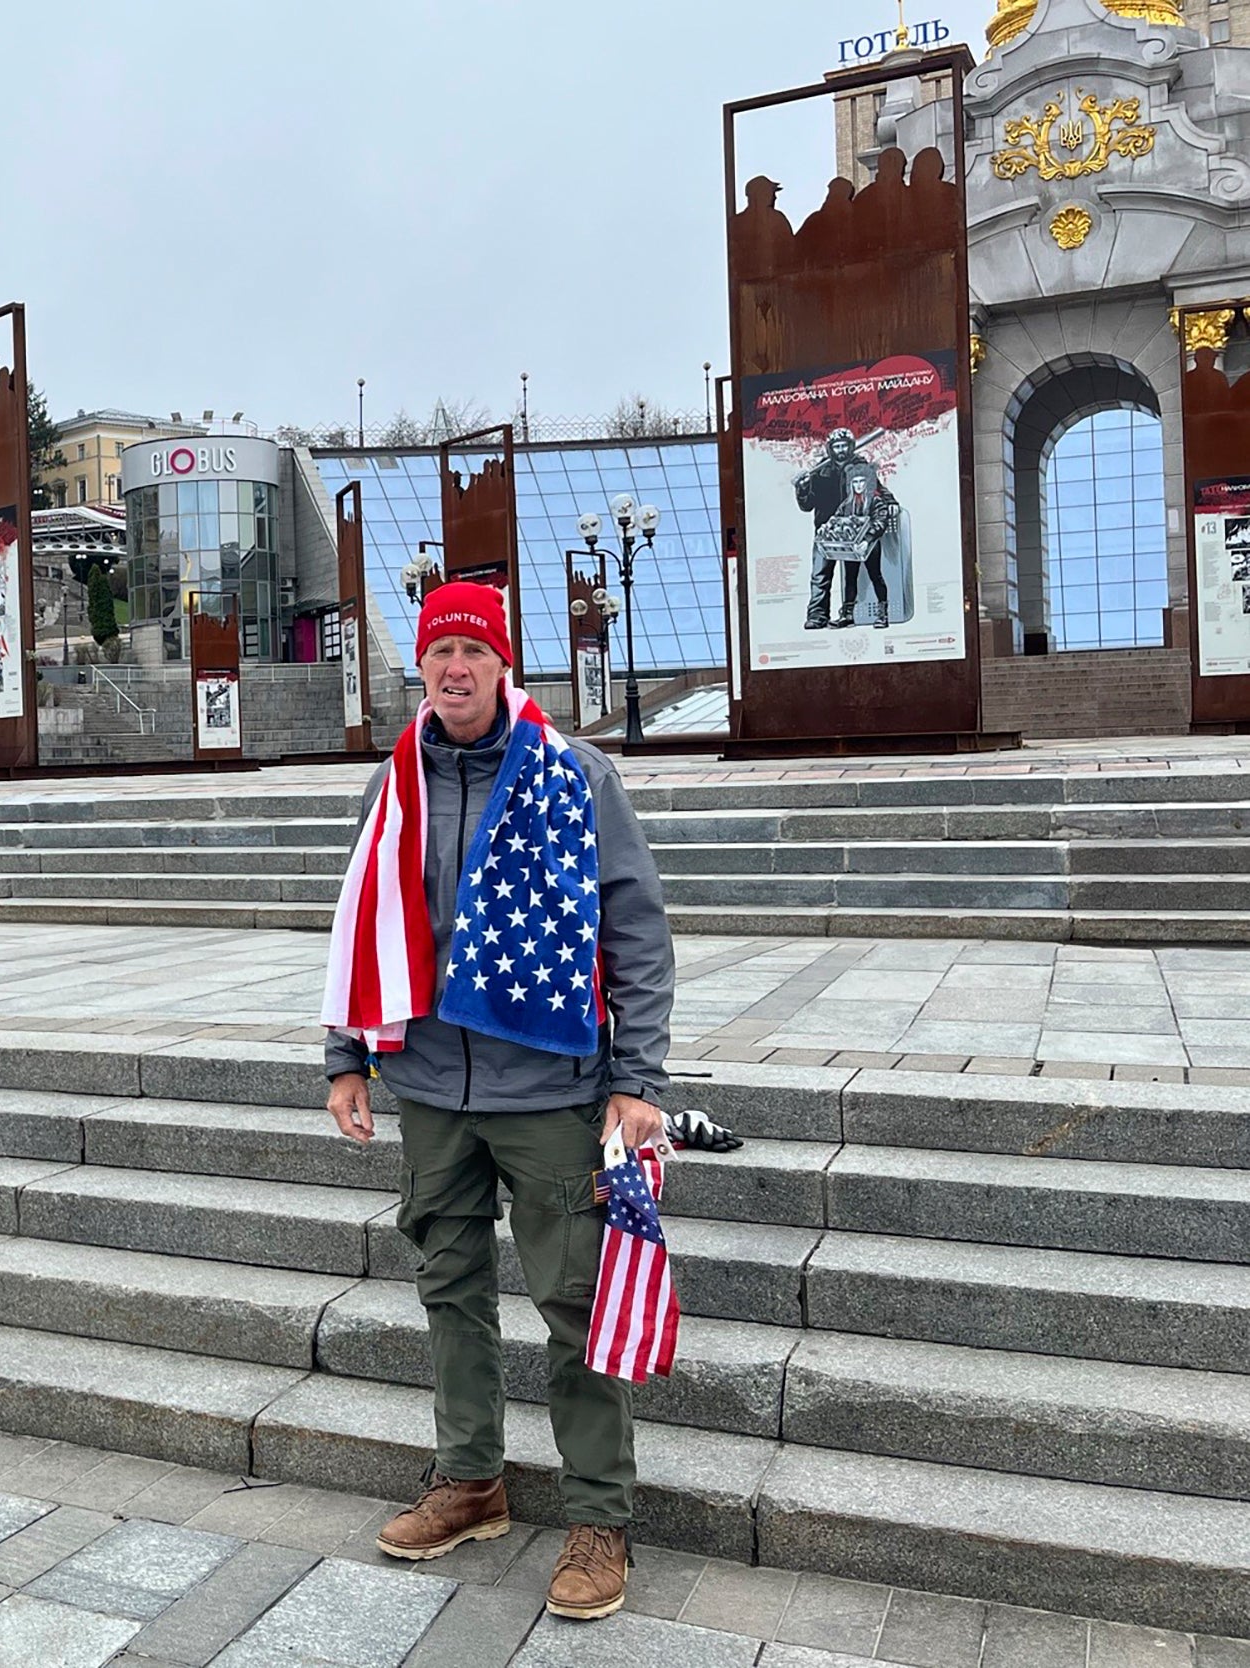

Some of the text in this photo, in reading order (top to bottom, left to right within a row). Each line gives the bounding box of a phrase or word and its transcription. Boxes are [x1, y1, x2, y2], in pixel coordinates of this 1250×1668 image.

[838, 19, 950, 63] ГОТЛЬ
[762, 389, 828, 406] МАЛЬОВАНА
[831, 382, 875, 398] ІСТОРІЯ
[878, 374, 935, 391] МАЙДАНУ
[151, 446, 237, 477] GLOBUS
[426, 612, 488, 630] VOLUNTEER
